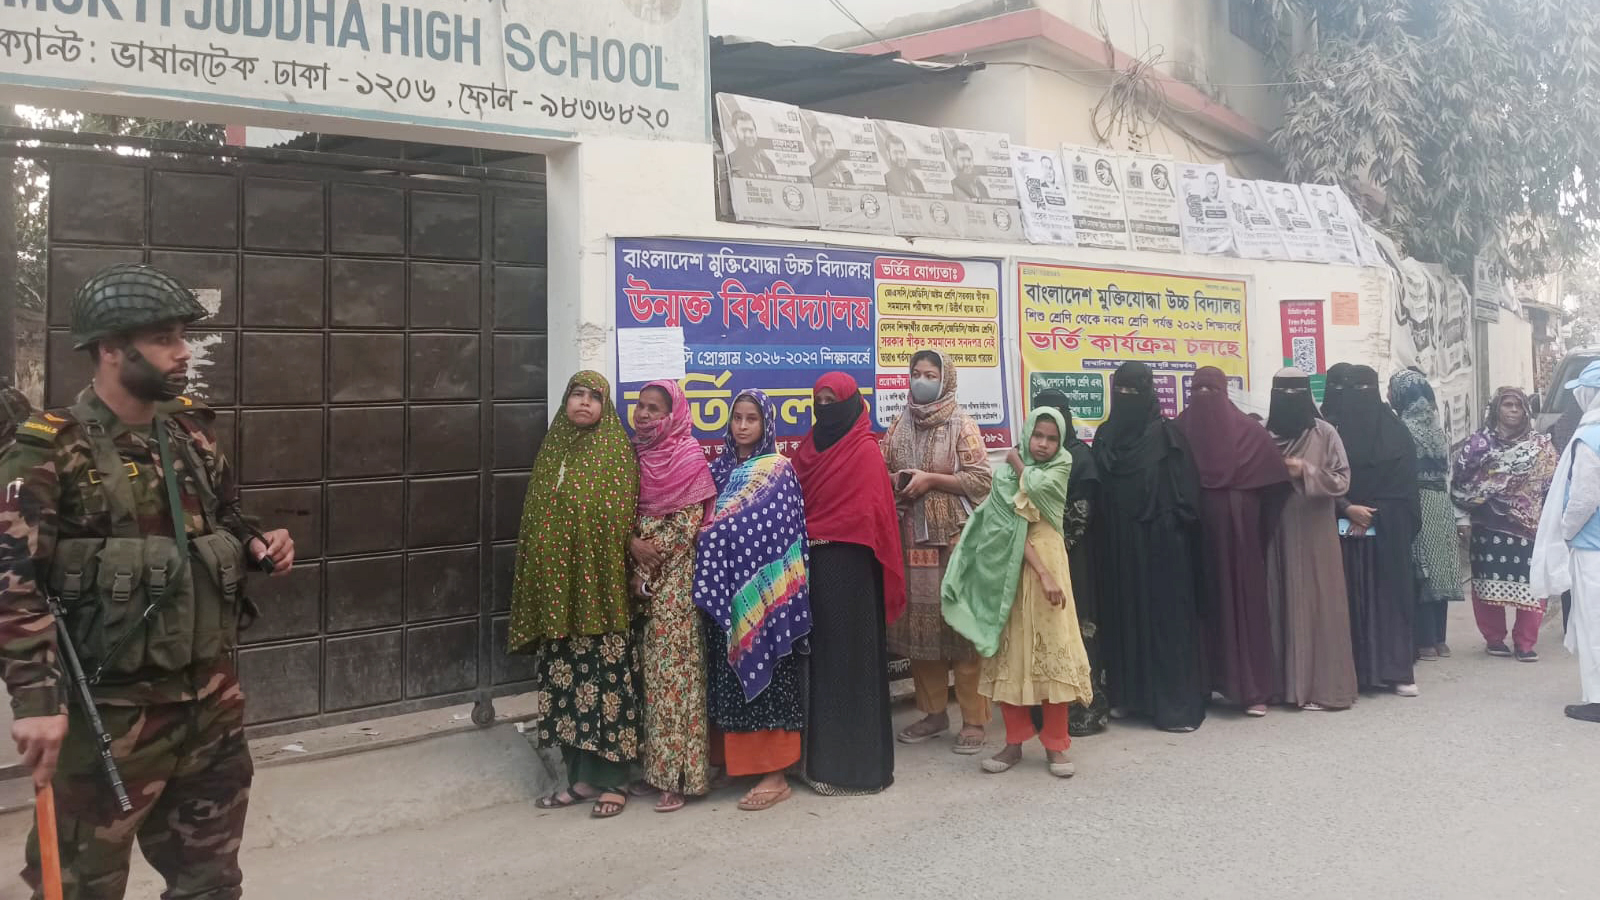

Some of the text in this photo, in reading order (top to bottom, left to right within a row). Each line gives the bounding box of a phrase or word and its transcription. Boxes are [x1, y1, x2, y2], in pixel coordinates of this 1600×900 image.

[382, 2, 481, 66] HIGH
[504, 23, 680, 91] SCHOOL
[623, 247, 872, 280] বাংলাদেশ মুক্তিযোদ্ধা উচ্চ বিদ্যালয়
[881, 259, 958, 280] ভর্তির যোগ্যতাঃ
[623, 274, 873, 332] উন্মক্ত বিশ্ববিদ্যালয়
[1024, 282, 1241, 316] বাংলাদেশ মুক্তিযোদ্ধা উচ্চ বিদ্যালয়
[1024, 308, 1242, 333] শিশু শ্রেণি থেকে নবম শ্রেণি পর্যন্ত ২০২৬ শিক্ষাবর্ষে
[697, 349, 742, 366] প্রোগ্রাম
[744, 352, 819, 365] ২০২৬-২০২৭
[820, 345, 871, 366] শিক্ষাবর্ষে
[880, 336, 904, 347] সরকার
[983, 336, 995, 349] নেই
[1026, 326, 1242, 359] ভর্তি কার্যক্রম চলছে
